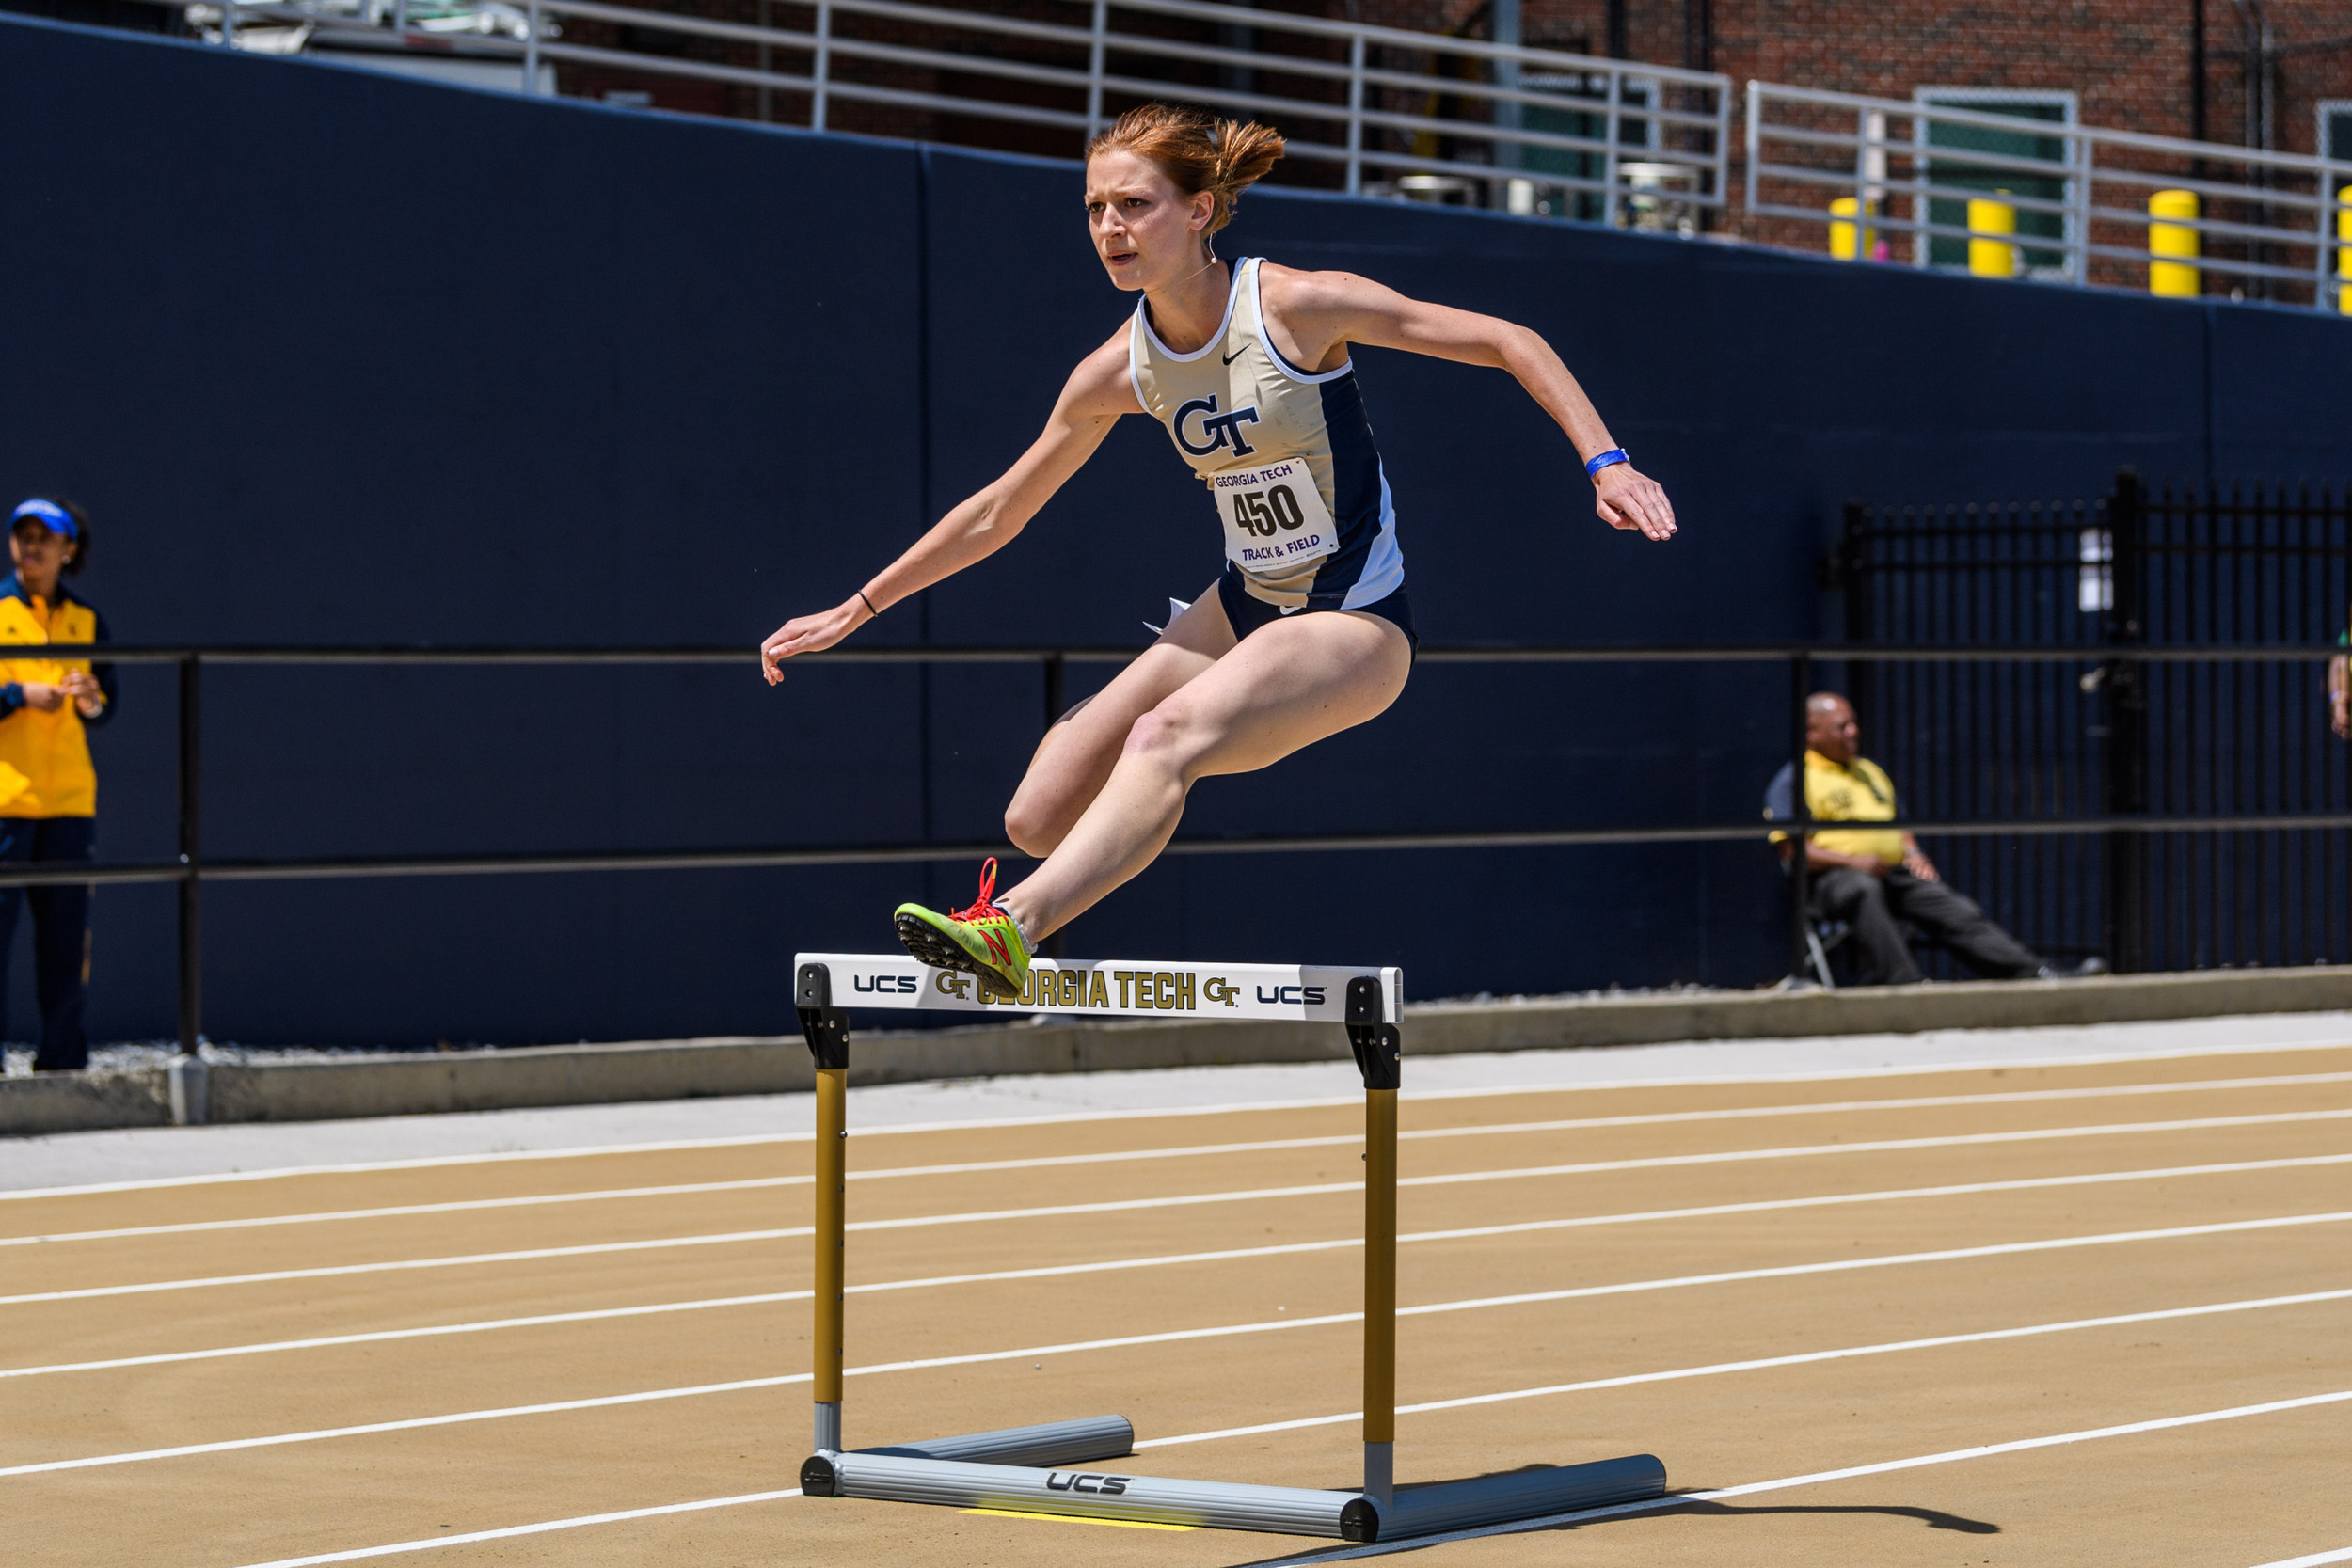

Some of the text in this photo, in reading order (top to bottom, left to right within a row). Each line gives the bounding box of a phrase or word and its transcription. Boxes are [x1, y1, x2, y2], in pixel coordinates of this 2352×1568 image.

[1173, 392, 1260, 458] GT
[1216, 464, 1294, 488] GEORGIA TECH
[1232, 484, 1305, 538] 450
[1242, 546, 1274, 561] TRACK
[1275, 546, 1284, 558] &
[1286, 533, 1320, 554] FIELD
[854, 975, 917, 993] UCS
[1114, 971, 1196, 1010] TECH
[1203, 977, 1240, 1007] GT
[1256, 985, 1327, 1005] UCS
[1046, 1472, 1131, 1495] UCS
